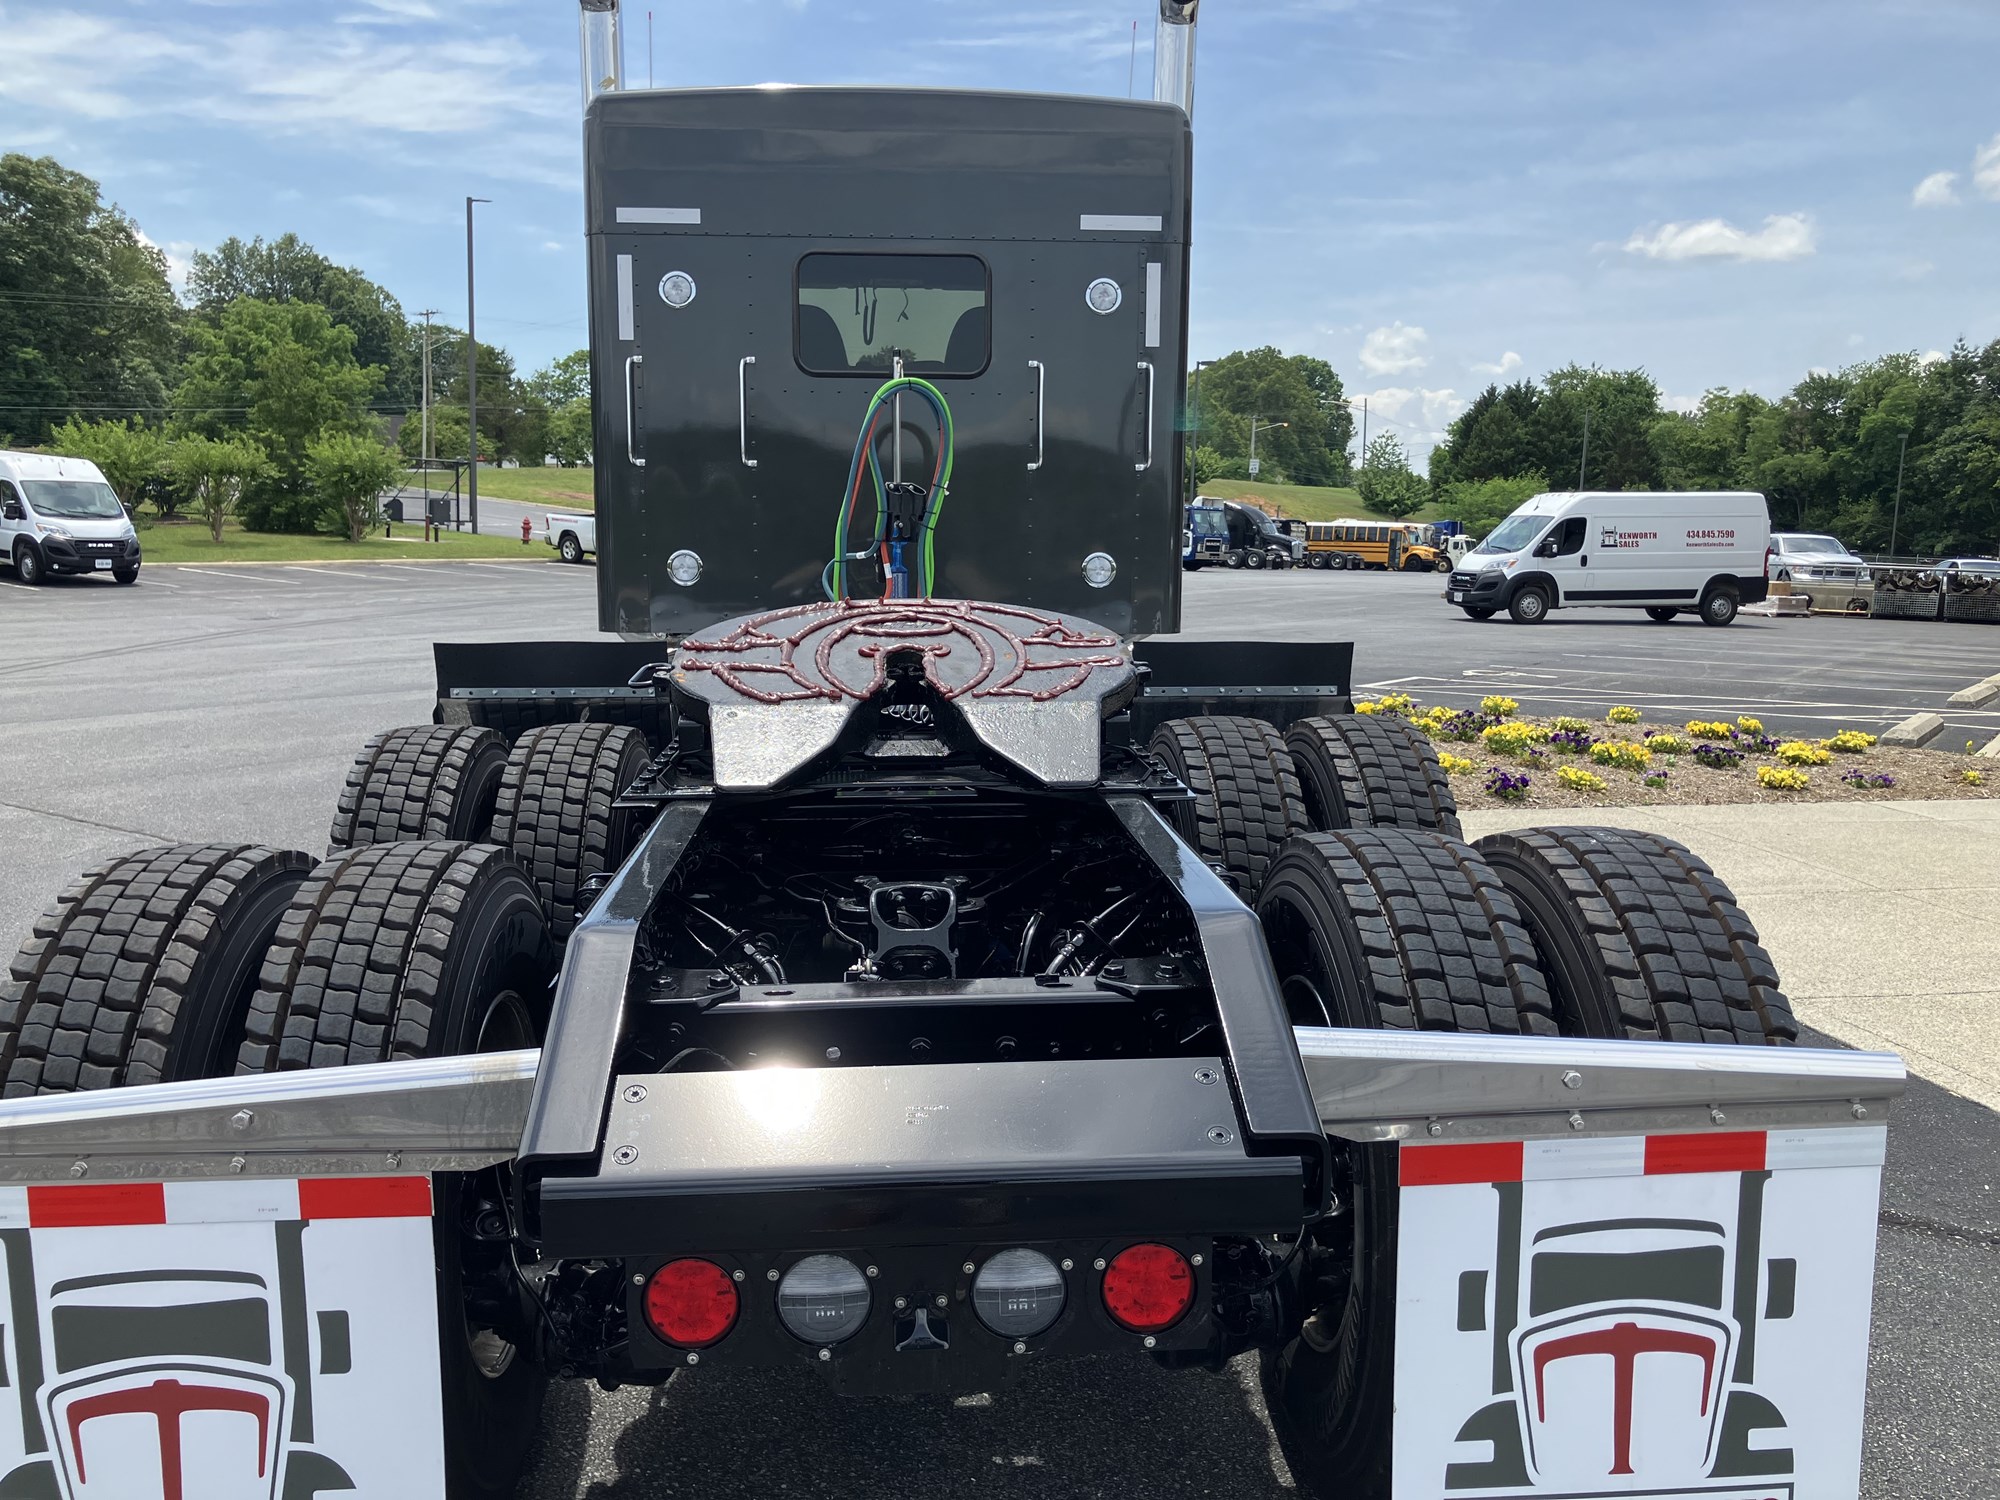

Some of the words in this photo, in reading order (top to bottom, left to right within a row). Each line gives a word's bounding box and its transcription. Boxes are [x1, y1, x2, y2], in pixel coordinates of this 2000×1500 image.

[1618, 532, 1657, 540] KENWORTH
[1686, 530, 1735, 539] 434.845.7590
[1618, 540, 1640, 548] SALES
